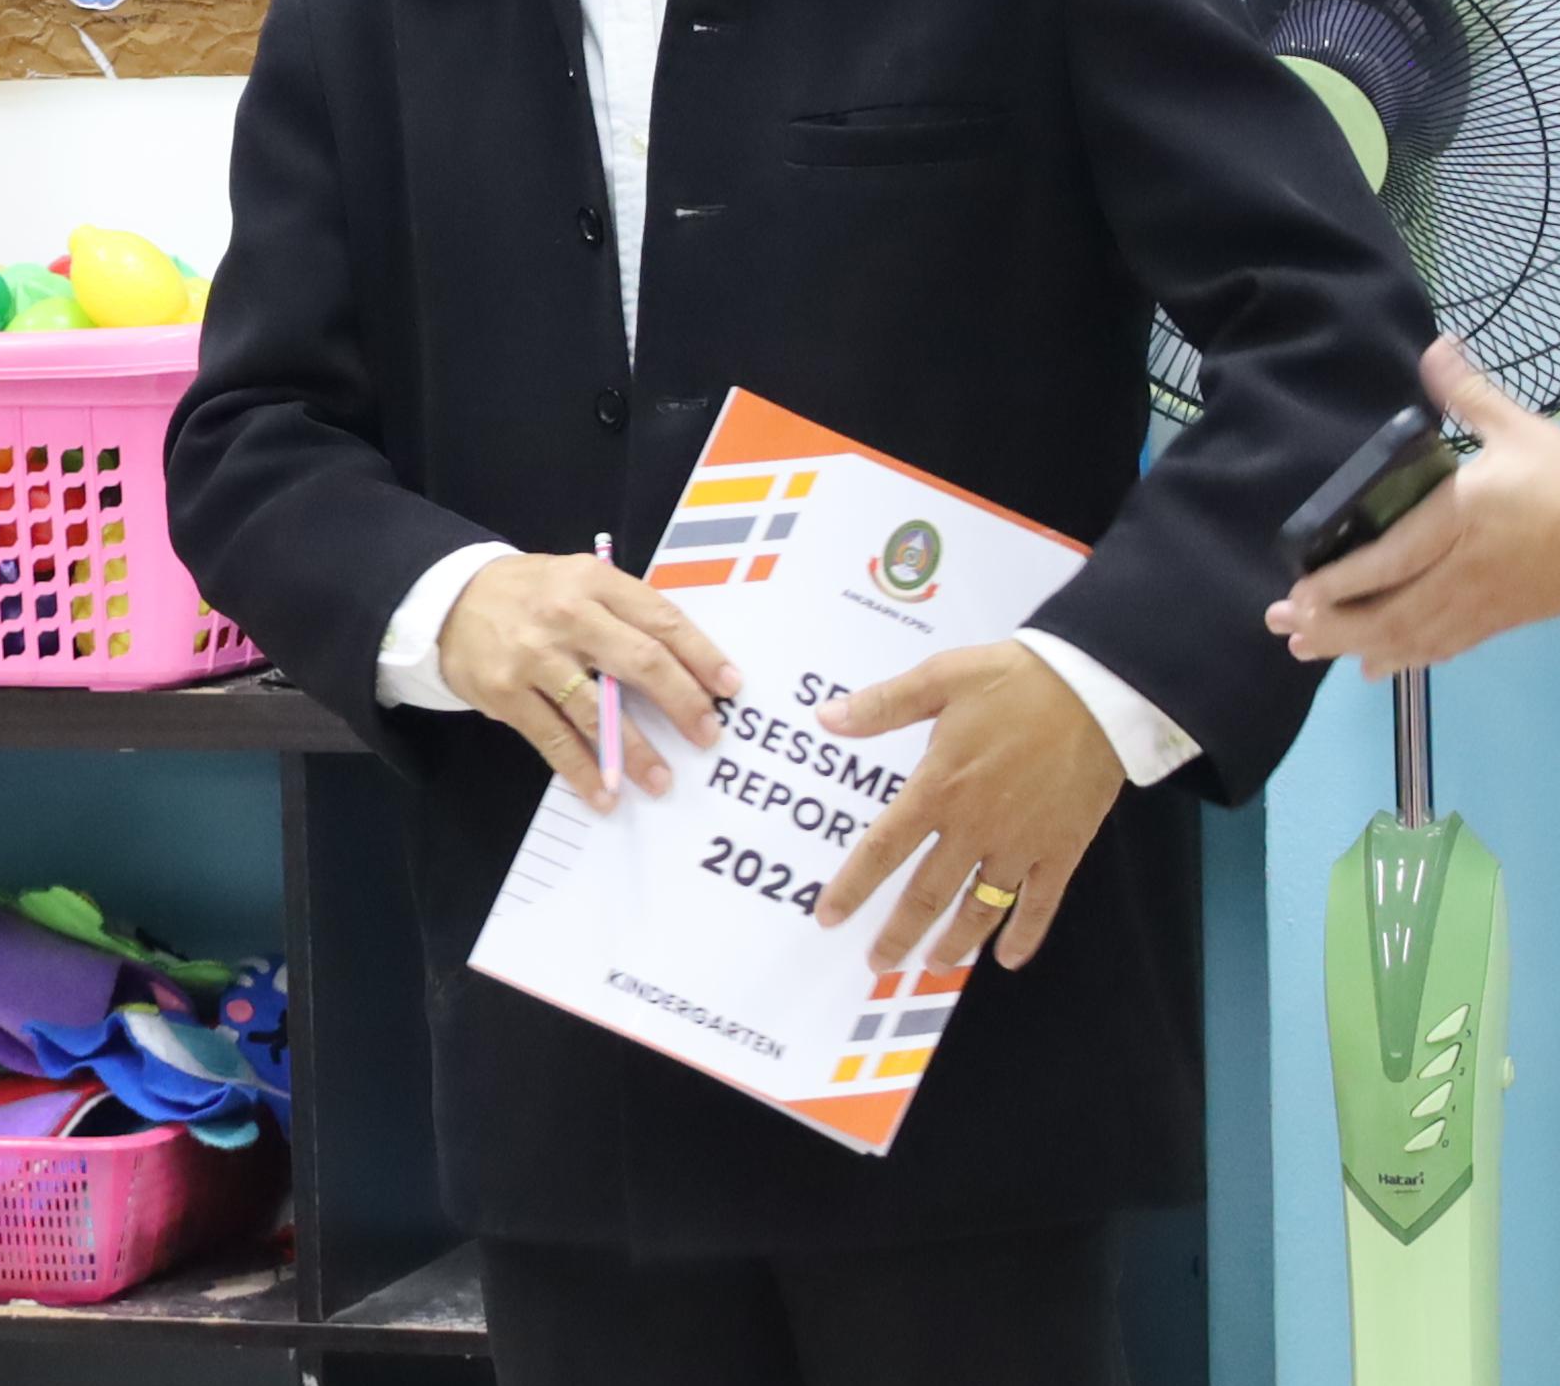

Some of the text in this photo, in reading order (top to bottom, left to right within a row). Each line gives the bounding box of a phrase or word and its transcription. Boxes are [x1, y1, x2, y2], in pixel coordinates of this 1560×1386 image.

[713, 696, 907, 806] SSESSME
[705, 756, 873, 849] REPOR
[699, 835, 827, 917] 2024
[604, 967, 787, 1061] KINDERGARTEN
[1378, 1171, 1425, 1185] Hatari
